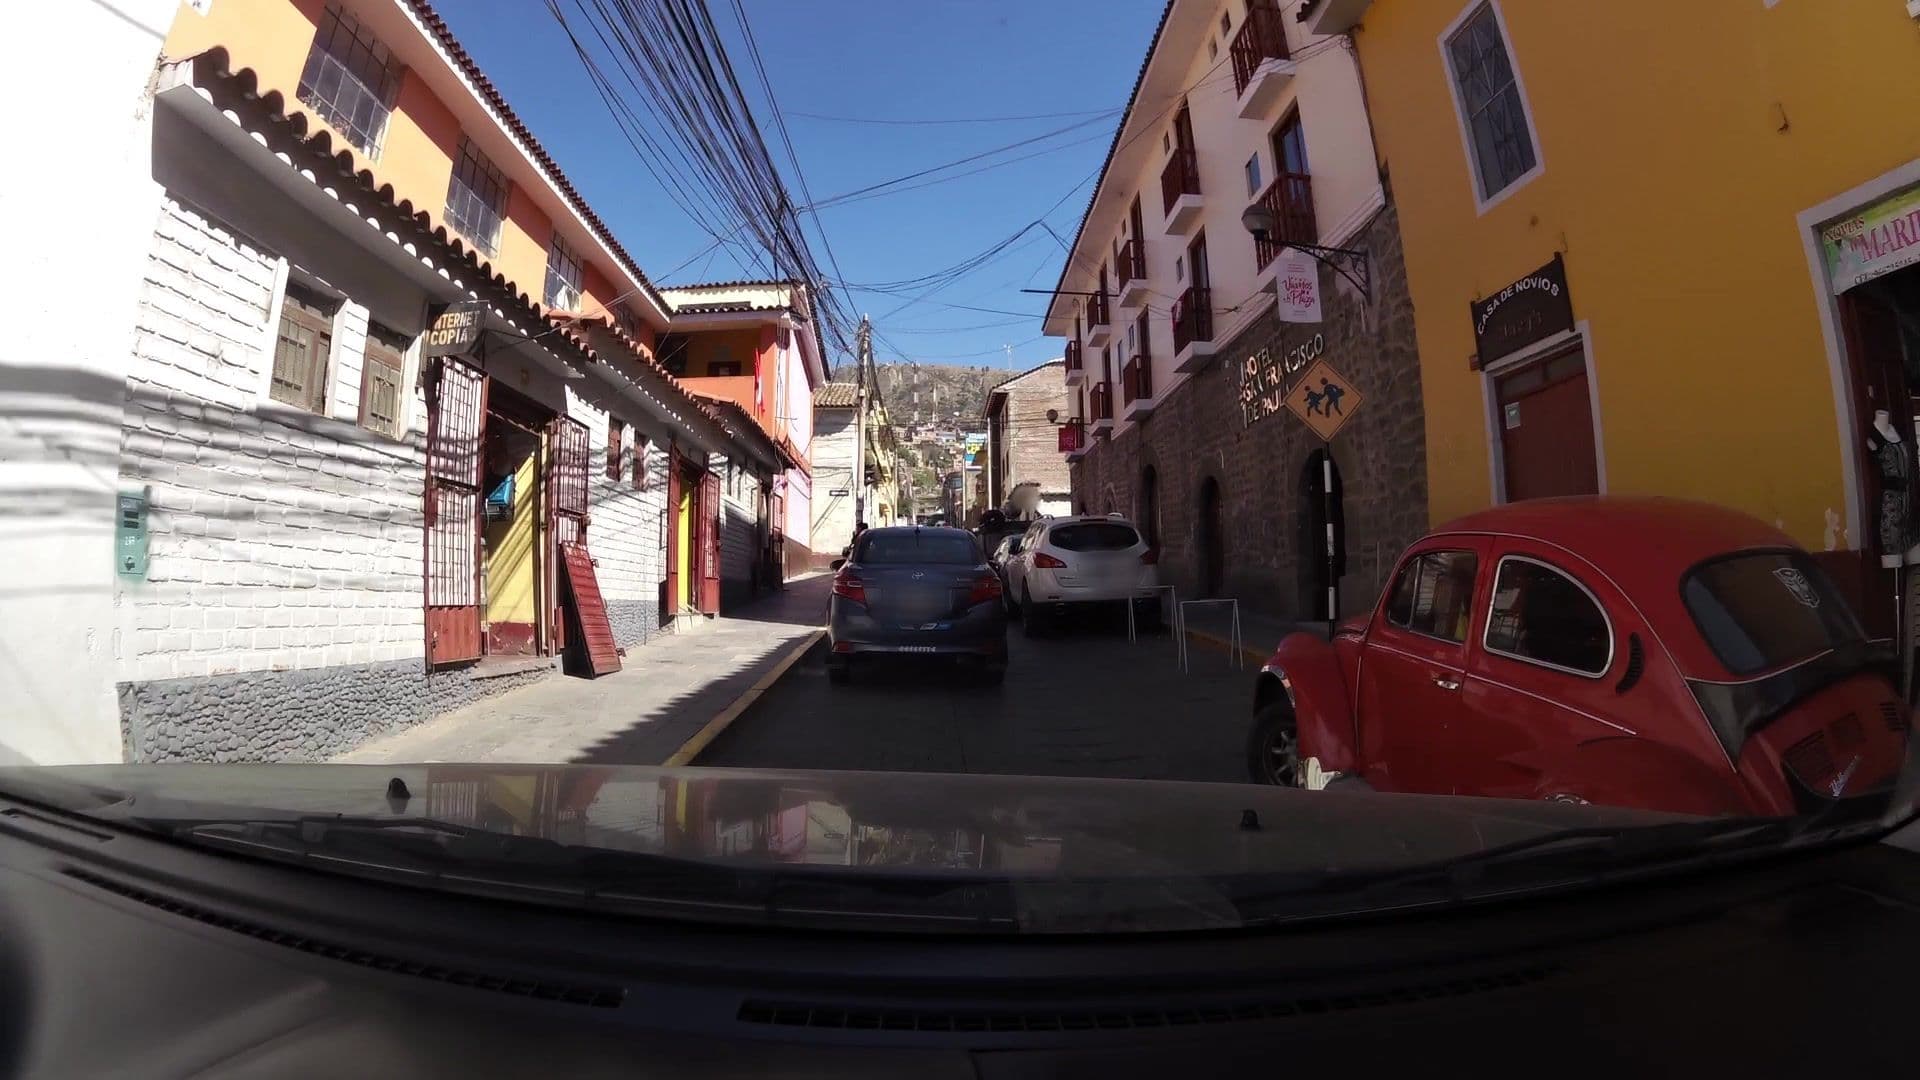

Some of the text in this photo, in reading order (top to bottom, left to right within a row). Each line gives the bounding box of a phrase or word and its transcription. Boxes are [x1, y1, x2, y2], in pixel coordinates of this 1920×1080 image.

[431, 310, 481, 330] NTERNET
[1477, 298, 1500, 335] CASA
[1500, 286, 1514, 303] DE
[1515, 277, 1560, 297] NOVIOS
